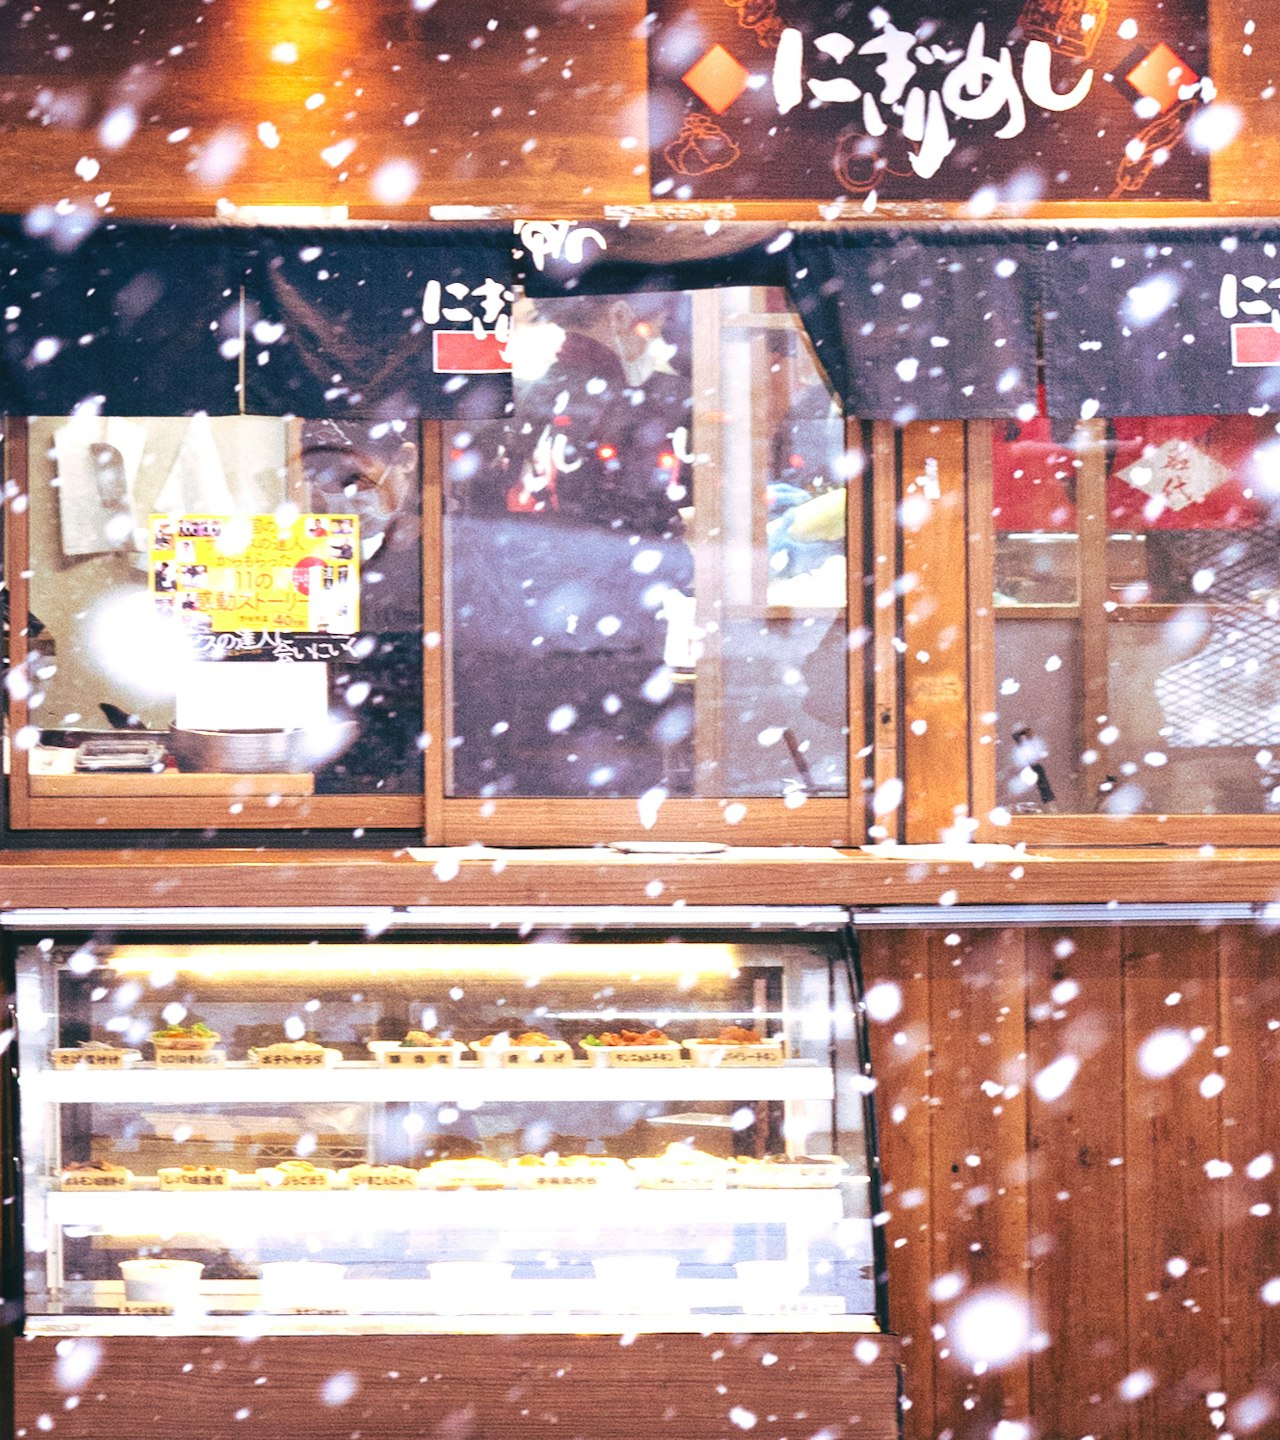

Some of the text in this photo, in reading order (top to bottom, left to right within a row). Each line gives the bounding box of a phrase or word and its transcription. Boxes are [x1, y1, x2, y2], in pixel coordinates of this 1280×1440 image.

[773, 20, 1094, 179] にぎりめし
